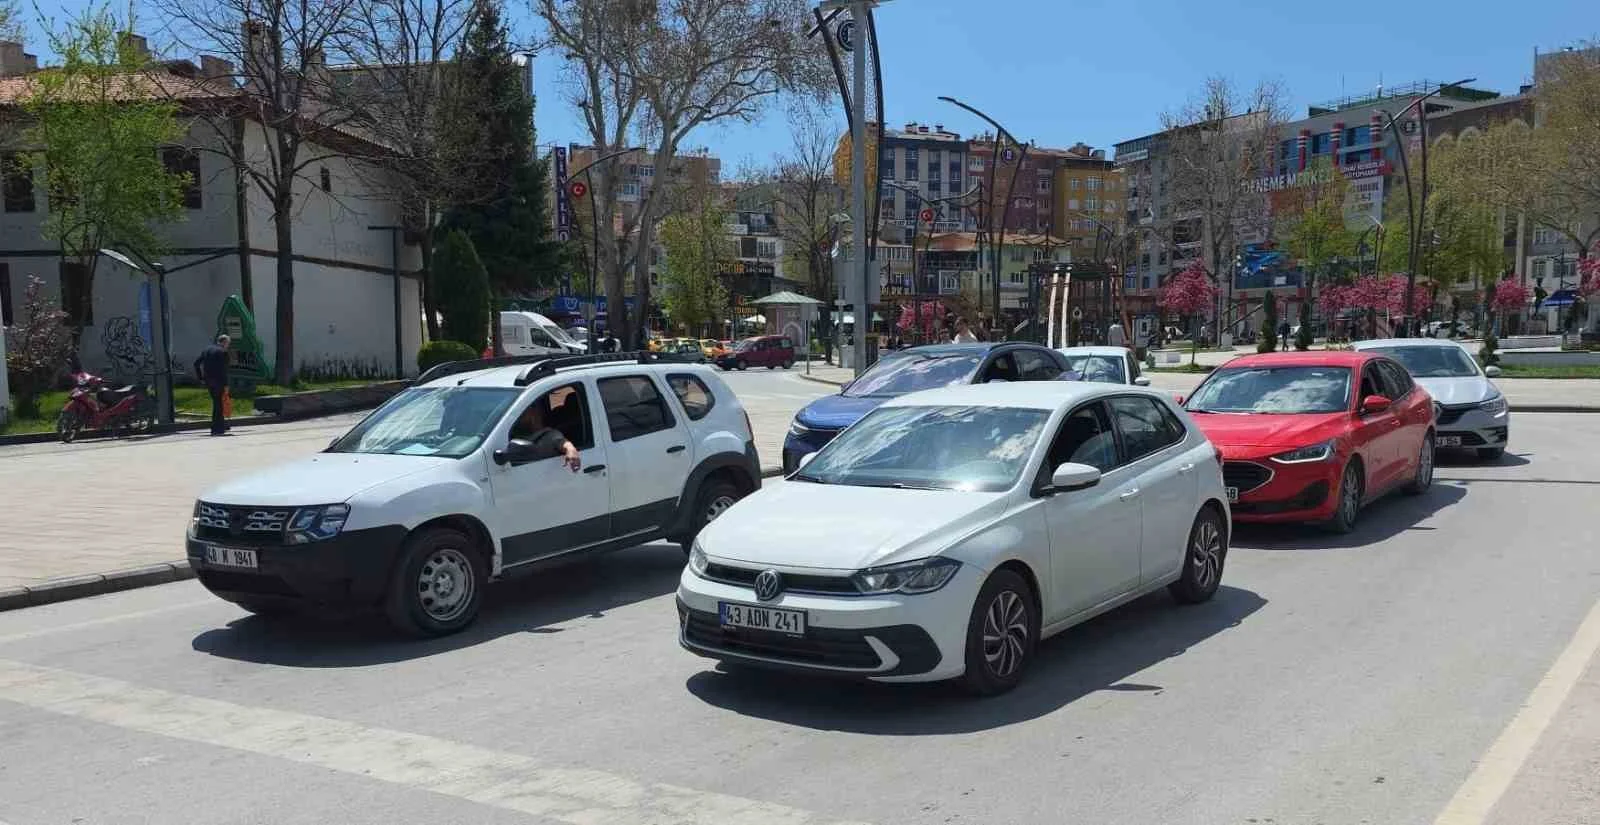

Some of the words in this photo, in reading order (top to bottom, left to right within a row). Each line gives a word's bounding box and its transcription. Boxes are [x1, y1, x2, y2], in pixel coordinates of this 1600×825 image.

[726, 604, 741, 624] 43
[747, 607, 770, 628] ADN
[775, 611, 799, 632] 241
